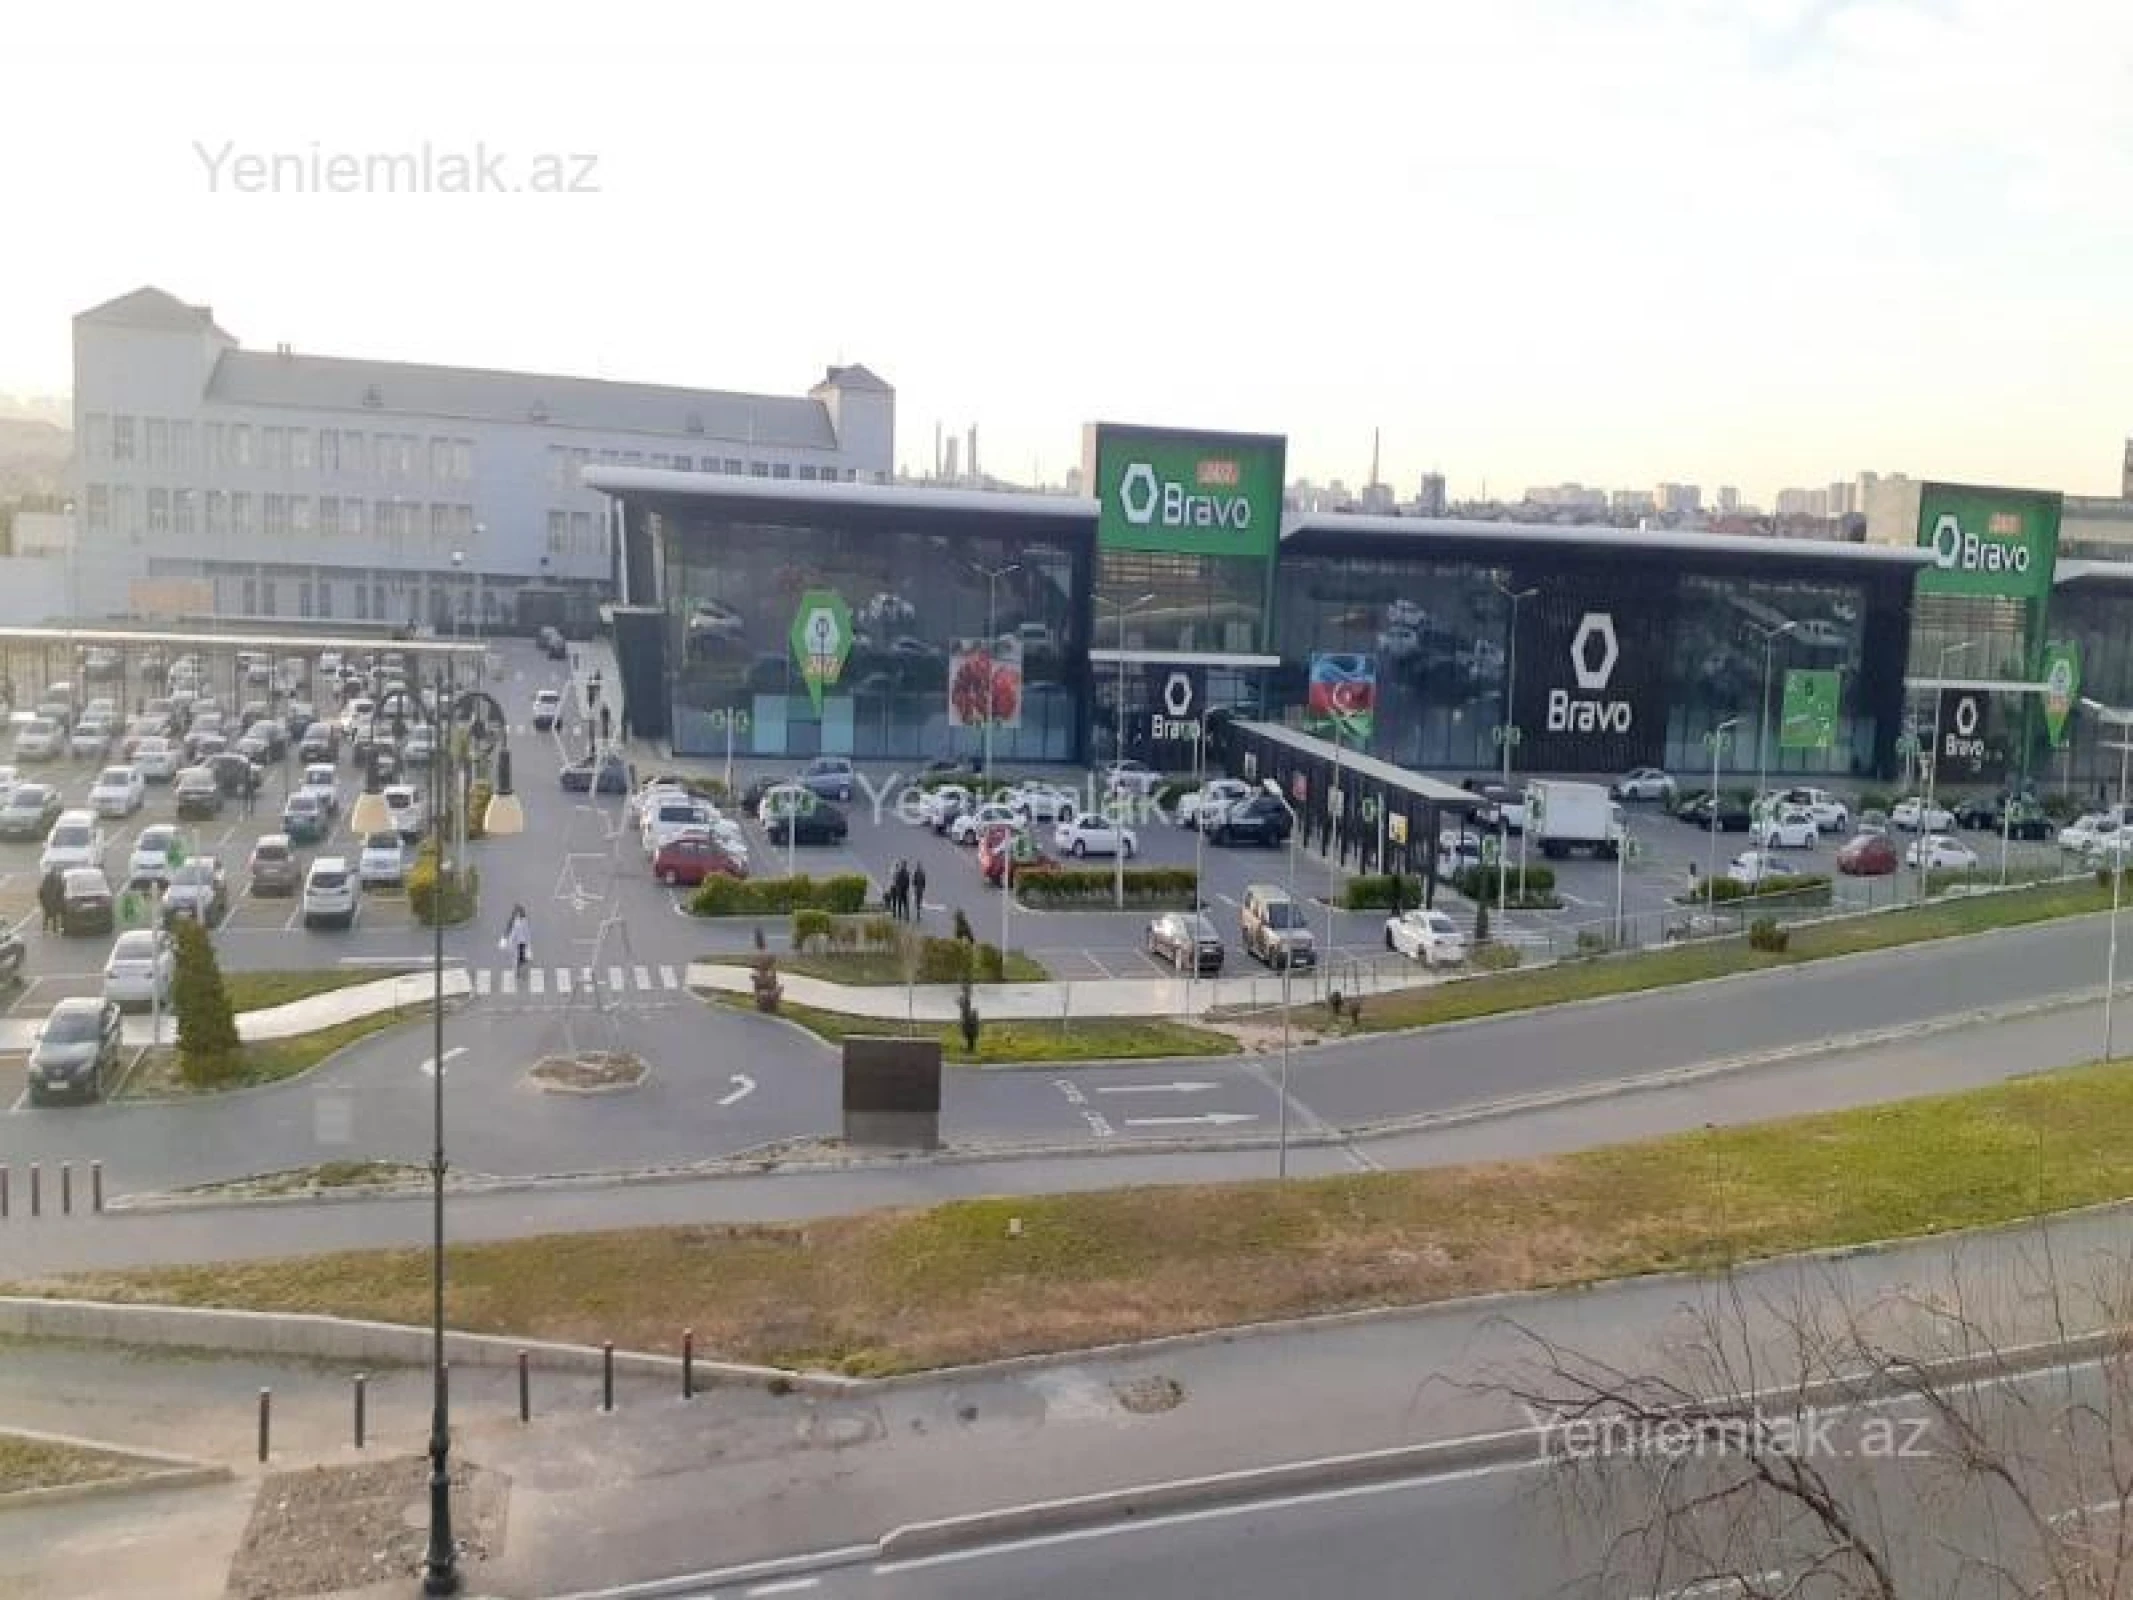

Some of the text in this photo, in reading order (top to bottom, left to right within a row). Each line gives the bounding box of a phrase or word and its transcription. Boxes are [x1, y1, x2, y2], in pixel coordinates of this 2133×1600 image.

[1162, 482, 1251, 529] Bravo
[1963, 533, 2030, 572] Bravo
[1548, 688, 1632, 734] Bravo
